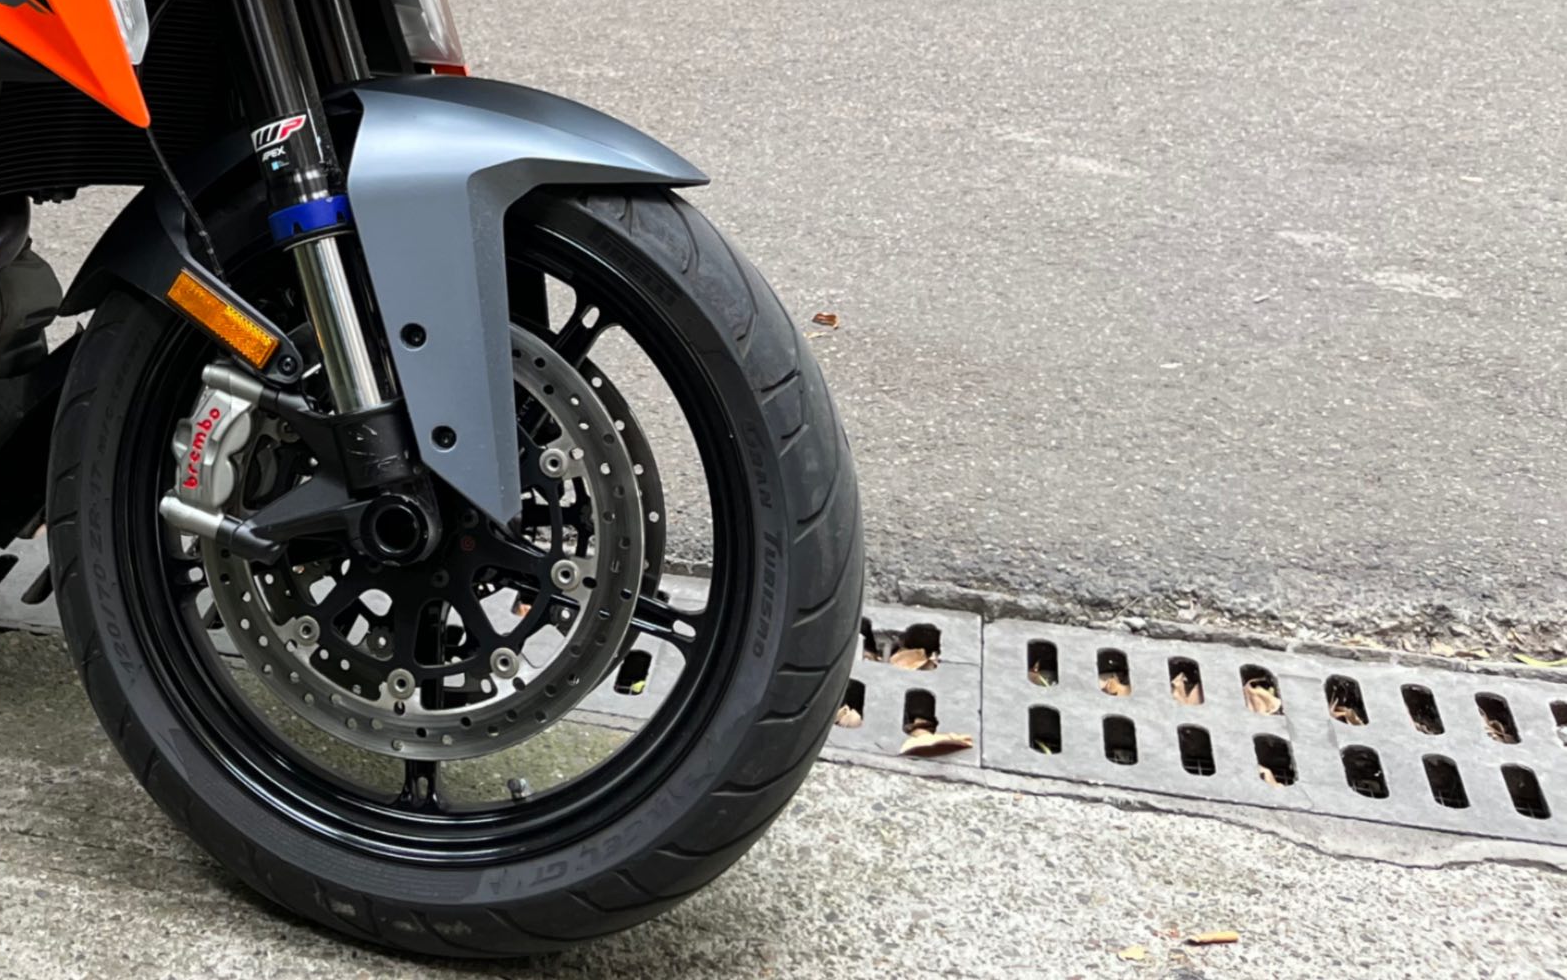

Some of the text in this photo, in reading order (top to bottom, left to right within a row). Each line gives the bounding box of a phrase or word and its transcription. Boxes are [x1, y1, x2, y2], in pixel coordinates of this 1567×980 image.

[253, 116, 305, 151] WP
[183, 408, 220, 489] brembo
[752, 531, 784, 658] TURISMO
